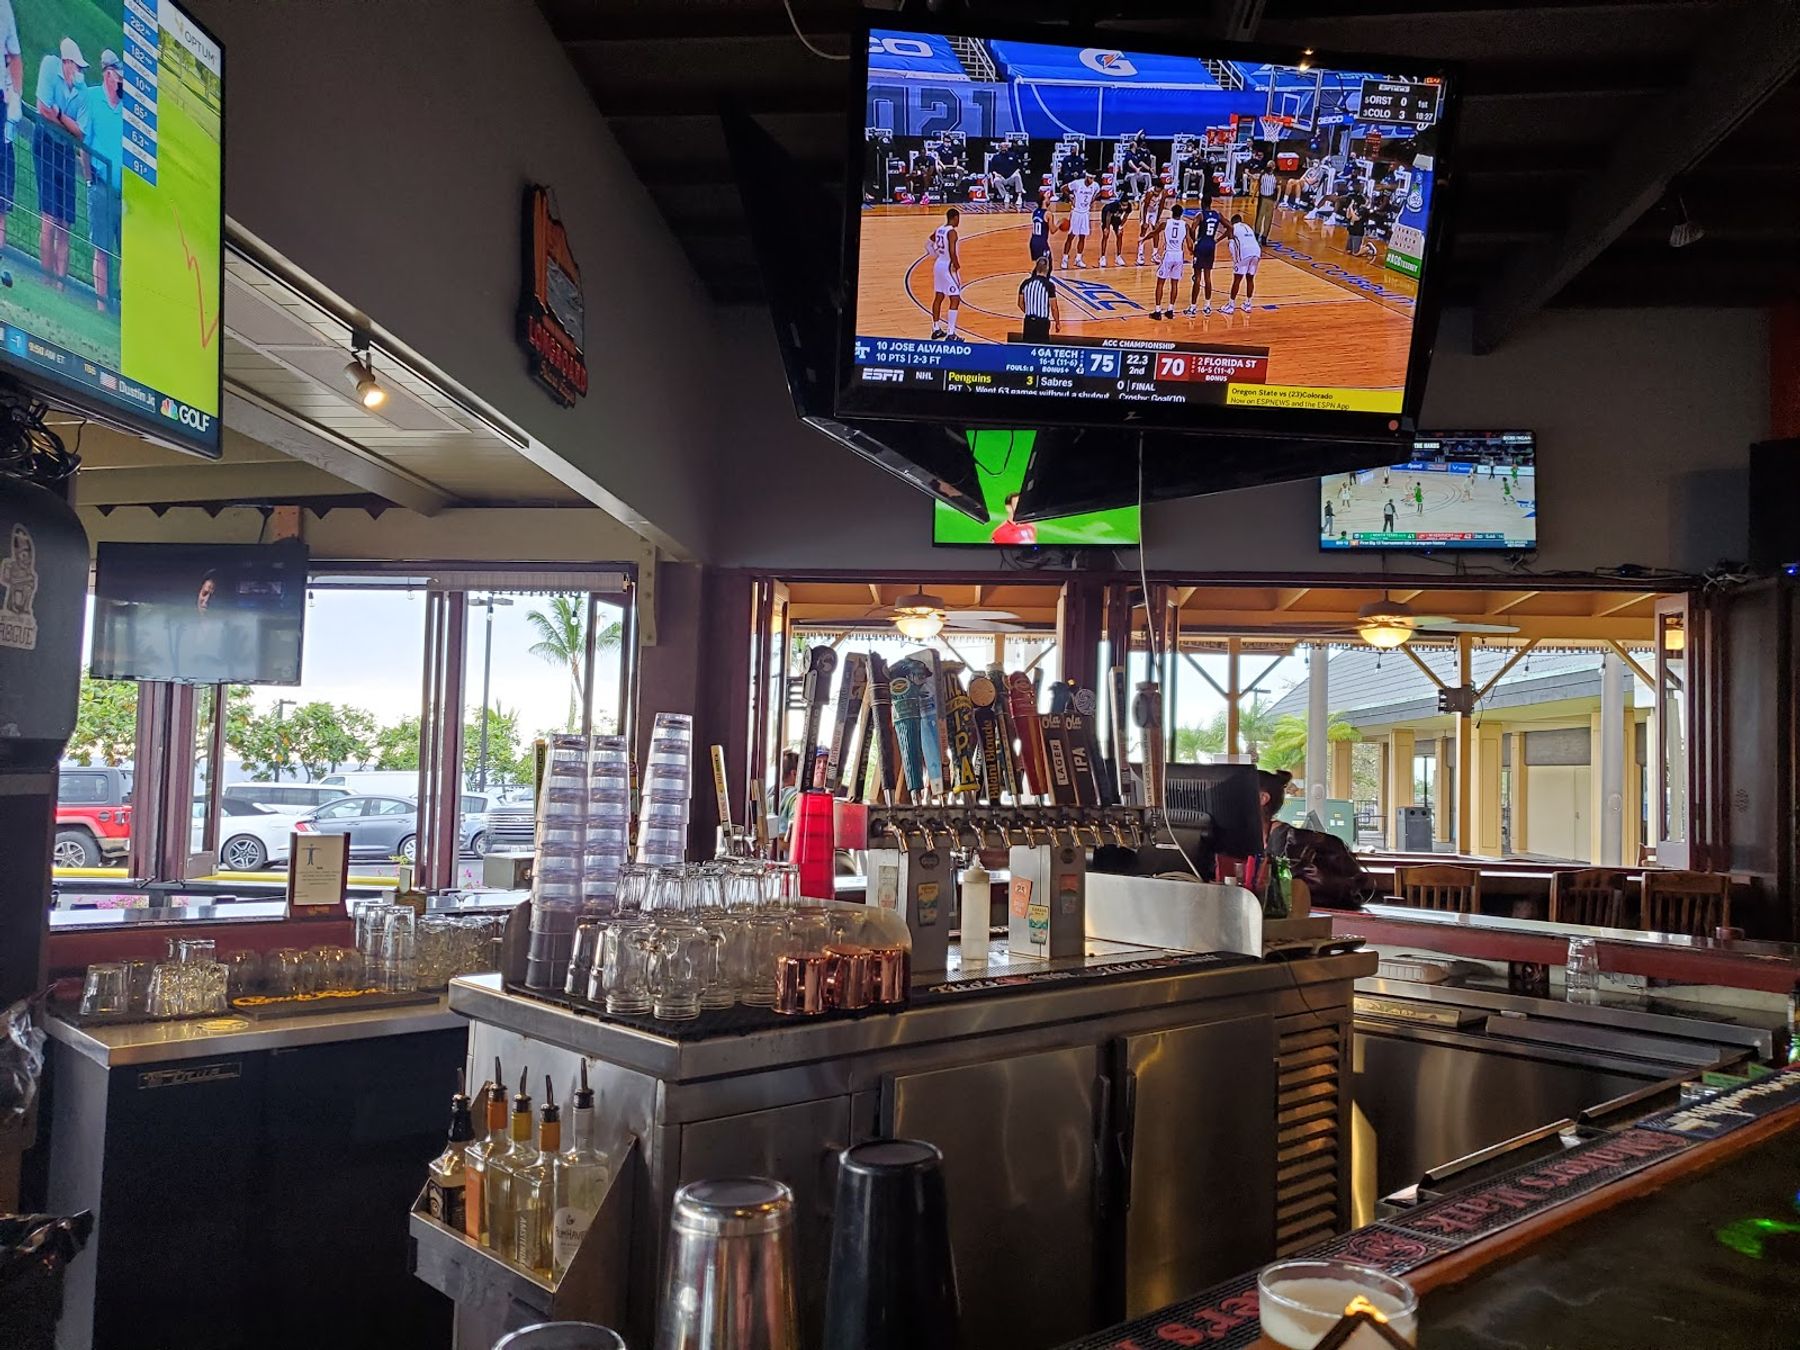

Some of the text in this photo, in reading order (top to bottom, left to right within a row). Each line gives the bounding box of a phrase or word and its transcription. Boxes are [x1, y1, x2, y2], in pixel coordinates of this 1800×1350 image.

[184, 30, 214, 61] OPTUM
[1400, 96, 1408, 106] 0
[1318, 114, 1343, 125] GEICO
[1368, 109, 1391, 118] COLO
[1399, 110, 1405, 119] 3
[1206, 222, 1216, 236] 5
[876, 341, 971, 355] 10 JOSE ALVARADO
[1101, 339, 1176, 350] ACC CHAMPIONSHIP
[876, 353, 941, 365] 10 PTS 2-3 FT
[1030, 348, 1078, 359] 4 GA TECH
[1126, 354, 1149, 365] 22.3
[1090, 354, 1114, 373] 75
[1161, 357, 1185, 376] 70
[1198, 357, 1257, 368] 2 FLORIDA ST
[862, 367, 905, 382] ESPN
[915, 371, 933, 380] NHL
[1128, 366, 1145, 375] 2nd
[1213, 367, 1235, 375] (11-4)
[948, 372, 1156, 392] Penguins 3 Sabres 0 FINAL
[119, 380, 144, 401] Dustin
[1231, 388, 1257, 396] Oregon
[1259, 389, 1278, 397] State
[1256, 398, 1290, 407] ESPNEWS
[1317, 401, 1336, 409] ESPN
[1336, 402, 1350, 410] App
[178, 405, 210, 433] GOLF
[1065, 714, 1082, 730] Ola
[982, 719, 996, 762] Blonde
[1052, 744, 1066, 781] LAGER
[1072, 747, 1088, 772] IPA
